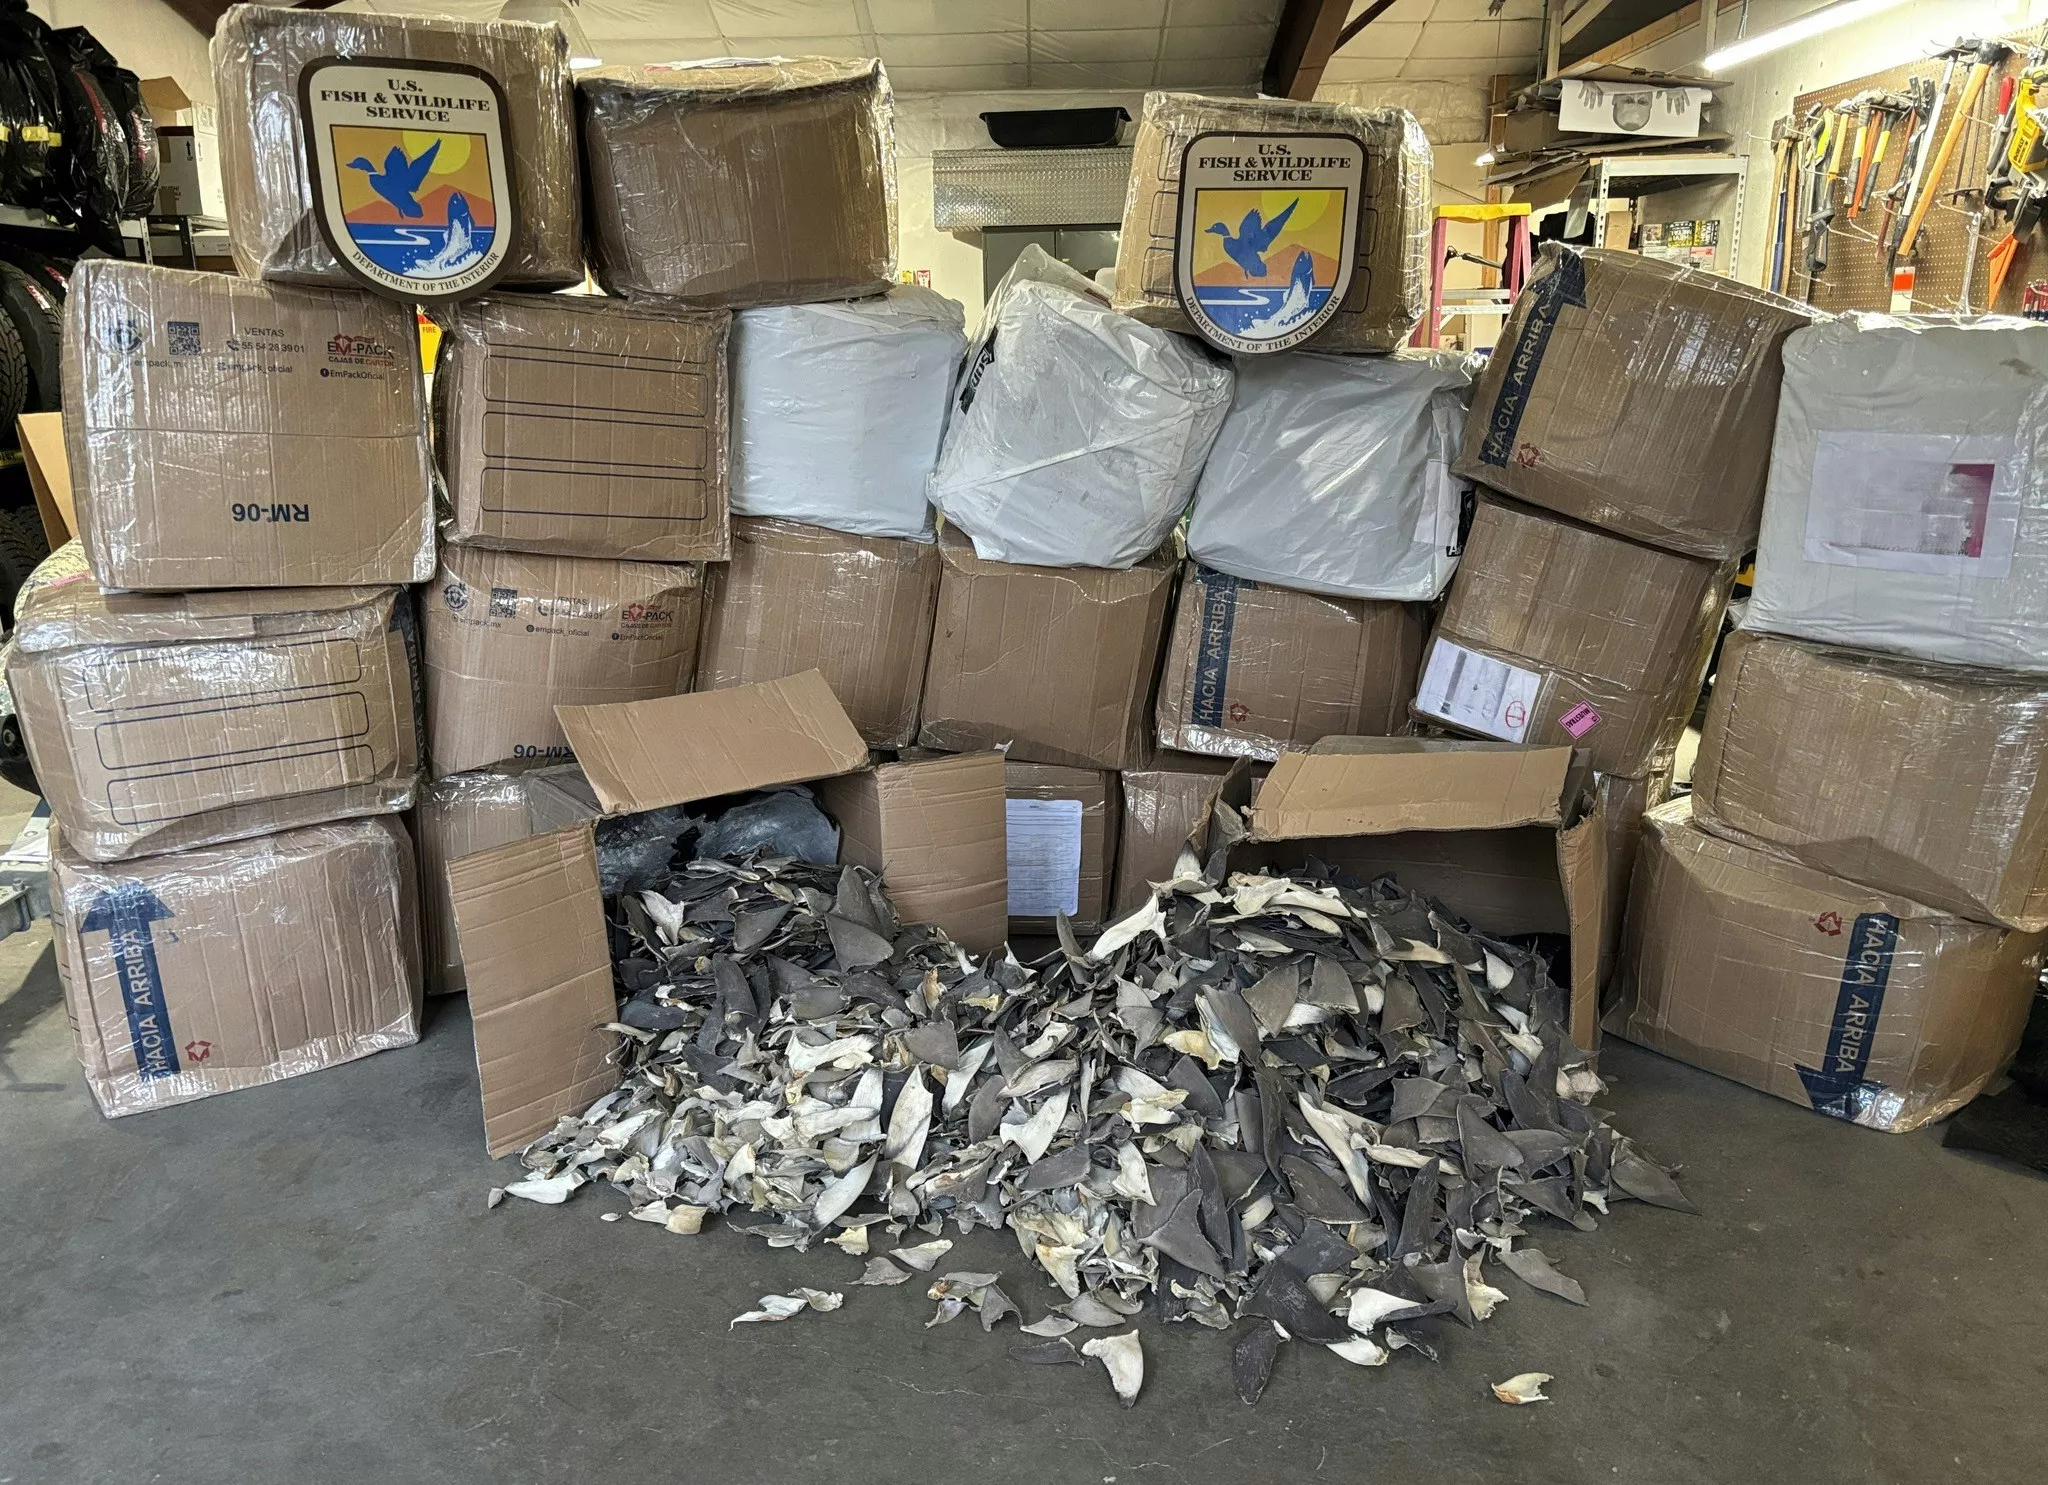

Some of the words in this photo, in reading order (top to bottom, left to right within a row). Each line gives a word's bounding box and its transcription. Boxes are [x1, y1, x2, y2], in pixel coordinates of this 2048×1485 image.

[387, 79, 423, 92] U.S.
[320, 90, 367, 103] FISH
[374, 92, 388, 104] &
[394, 94, 490, 112] WILDLIFE
[366, 106, 450, 122] SERVICE
[1258, 144, 1291, 155] U.S.
[1198, 157, 1241, 168] FISH
[1244, 156, 1258, 168] &
[1262, 157, 1351, 168] WILDLIFE
[1233, 169, 1312, 182] SERVICE
[352, 251, 423, 291] DEPARTMENT
[422, 283, 436, 292] OF
[438, 279, 460, 291] THE
[461, 252, 500, 285] INTERIOR
[244, 327, 285, 338] VENTAS
[1186, 296, 1244, 350] DEPARTMENT
[1246, 343, 1262, 351] OF
[1265, 337, 1292, 350] THE
[1294, 295, 1341, 341] INTERIOR
[242, 341, 253, 350] 55
[255, 343, 266, 351] 54
[328, 338, 395, 359] EM-PACK
[329, 356, 353, 364] CAJAS
[1488, 395, 1519, 458] HACIA
[1513, 303, 1551, 387] ARRIBA
[231, 503, 310, 522] RM-06
[622, 608, 674, 621] EM-PACK
[1207, 589, 1227, 660] ARRIBA
[1200, 667, 1219, 721] HACIA
[1857, 918, 1889, 985] HACIA
[119, 928, 154, 1006] ARRIBA
[138, 1014, 170, 1073] HACIA
[1835, 993, 1870, 1073] ARRIBA
